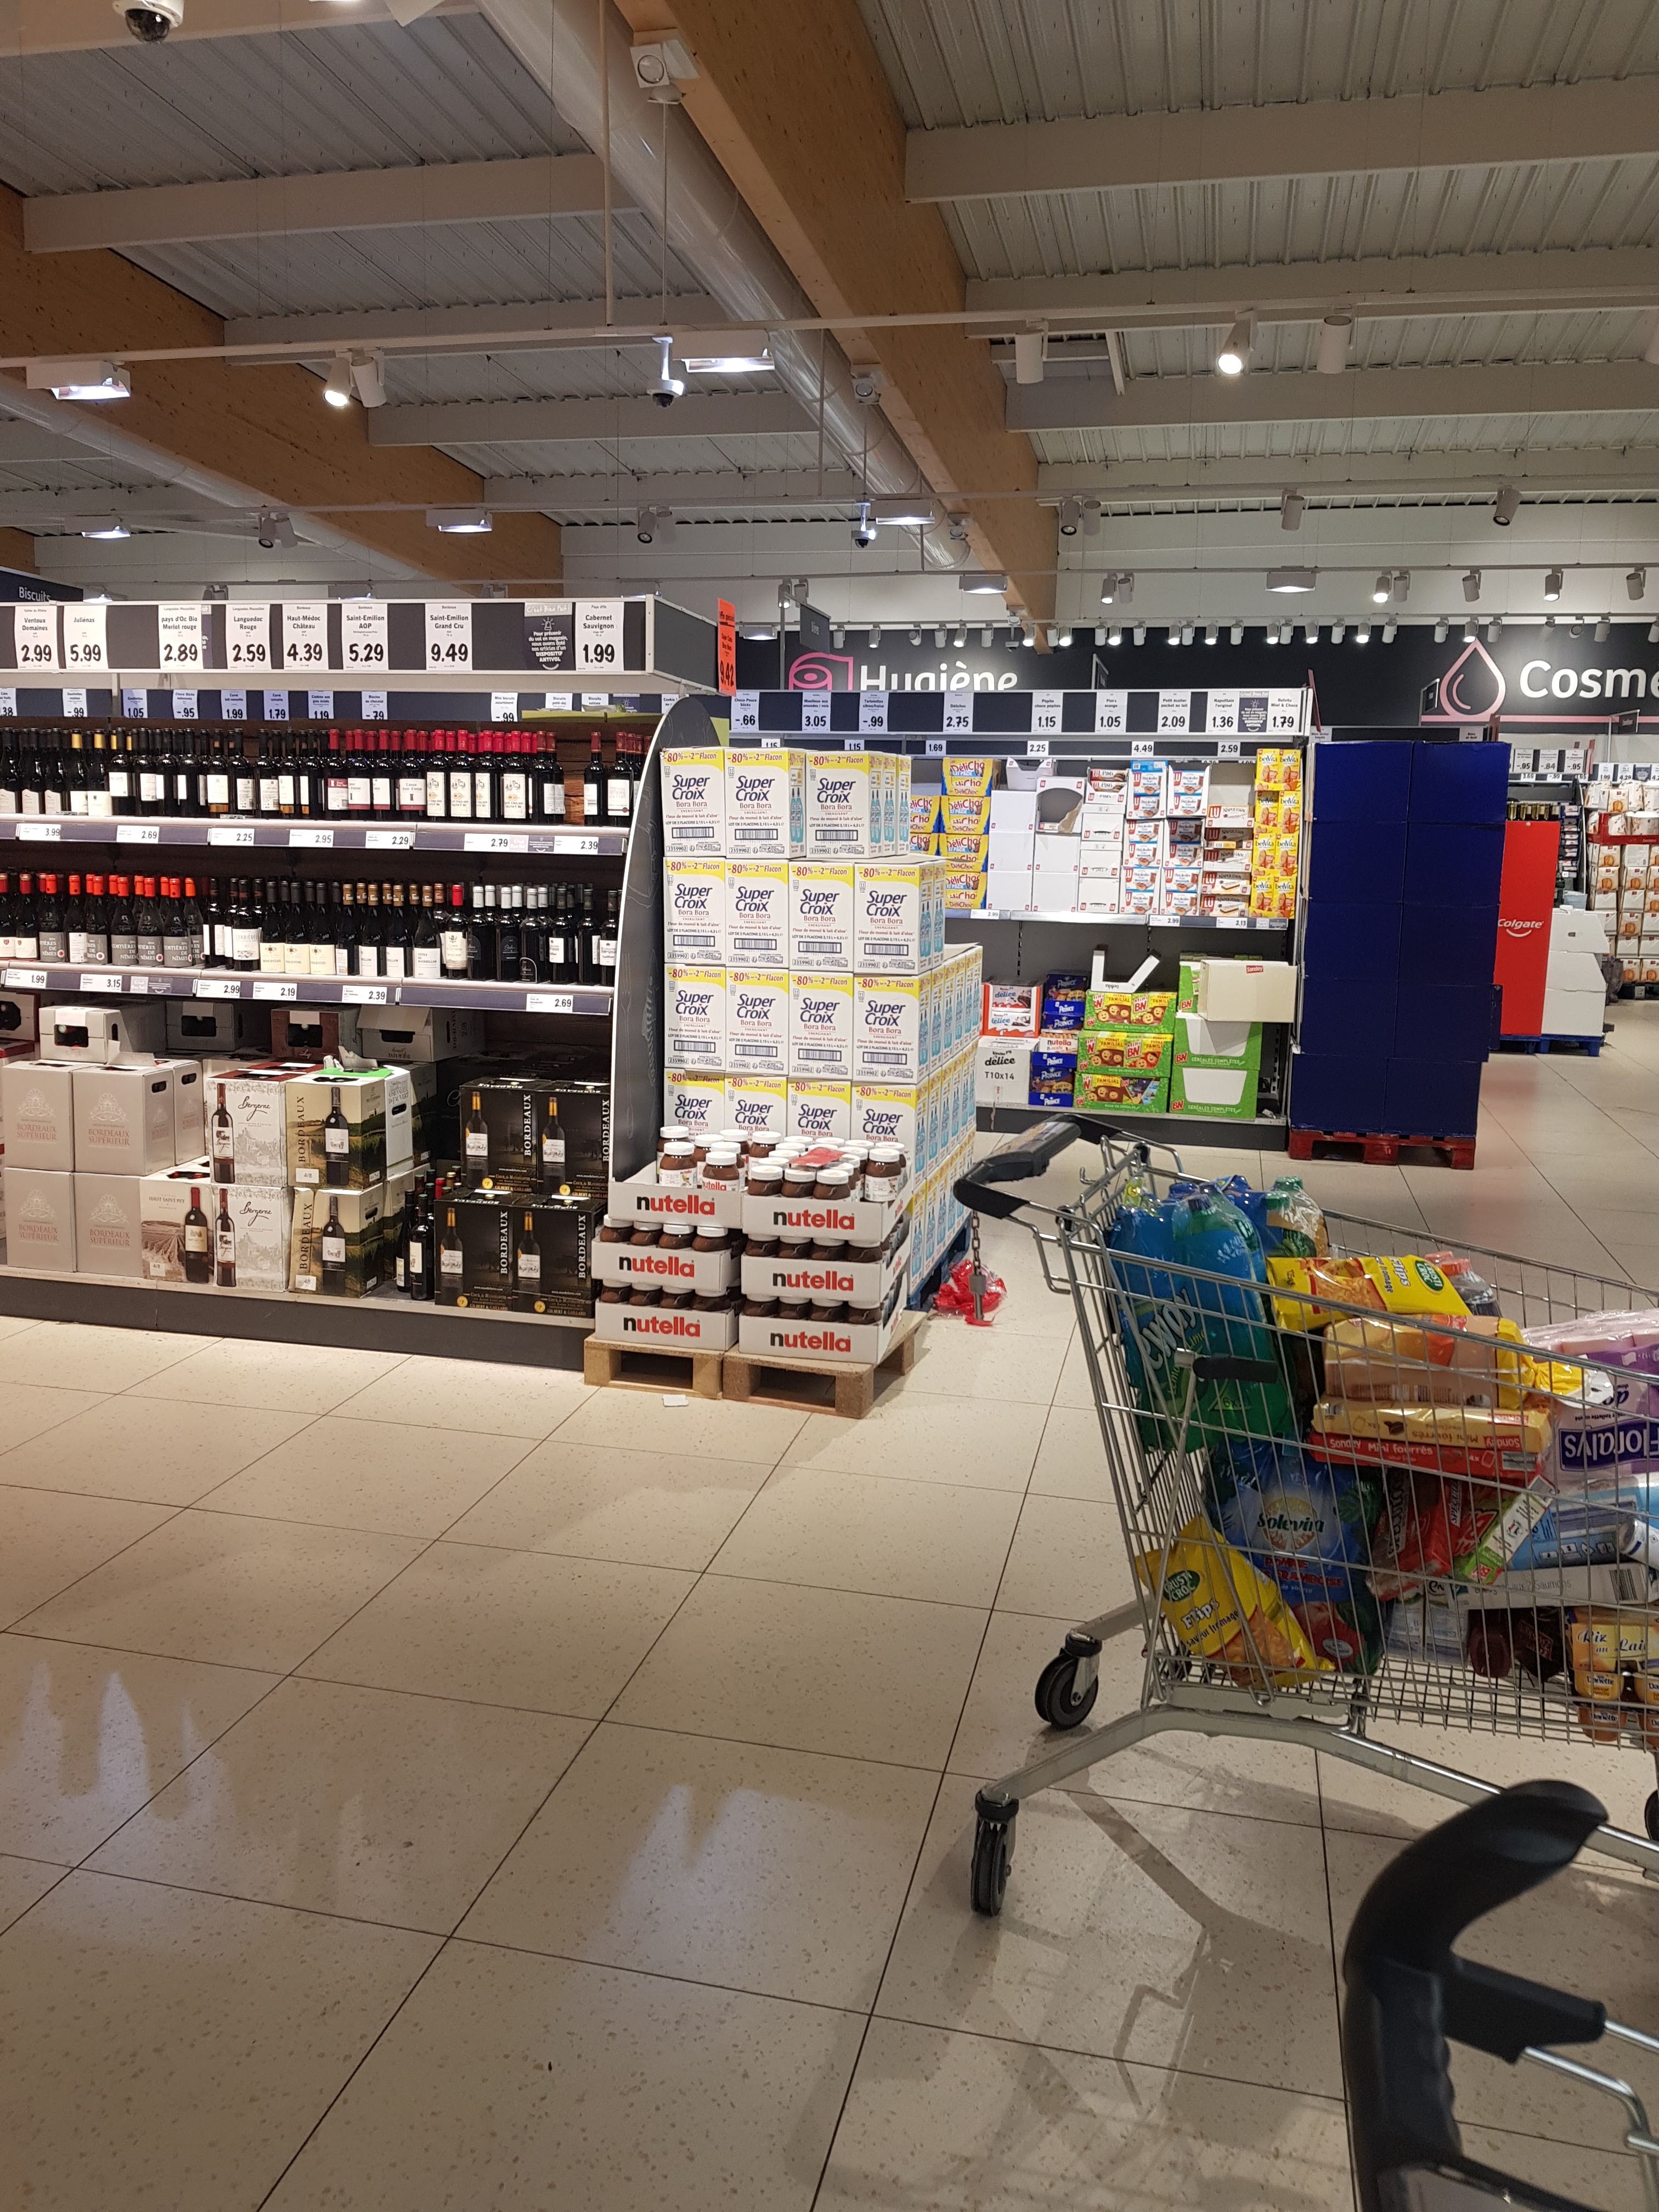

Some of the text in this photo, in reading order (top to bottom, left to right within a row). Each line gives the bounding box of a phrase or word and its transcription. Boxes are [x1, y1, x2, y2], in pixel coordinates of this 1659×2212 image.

[19, 586, 51, 602] Biscuits
[21, 644, 52, 662] 2.99
[70, 644, 101, 662] 5.99
[163, 644, 198, 662] 2.89
[232, 644, 266, 662] 2.59
[287, 643, 323, 662] 4.39
[349, 643, 383, 662] 5.29
[431, 643, 468, 662] 9.49
[583, 644, 615, 663] 1.99
[720, 662, 734, 687] 9.42
[128, 708, 144, 718] 1.05
[177, 708, 194, 718] -.95
[227, 709, 243, 719] 1.99
[269, 709, 285, 719] 1.79
[735, 715, 755, 726] -.66
[805, 715, 826, 727] 3.05
[862, 715, 883, 727] -.99
[946, 716, 969, 727] 2.75
[1038, 716, 1056, 727] 1.15
[1100, 716, 1121, 727] 1.05
[1161, 716, 1185, 727] 2.09
[1212, 716, 1233, 727] 1.36
[1272, 716, 1294, 728] 1.79
[1030, 744, 1046, 752] 2.25
[1134, 744, 1152, 753] 4.49
[672, 774, 710, 789] Super
[736, 775, 775, 791] Super
[818, 778, 856, 793] Super
[672, 787, 705, 800] Croix
[736, 788, 770, 801] Croix
[817, 790, 851, 803] Croix
[1209, 806, 1221, 817] LU
[45, 828, 60, 837] 3.99
[142, 831, 157, 839] 2.69
[236, 833, 252, 842] 2.25
[315, 835, 331, 844] 2.95
[392, 837, 409, 845] 2.29
[491, 838, 509, 848] 2.79
[580, 840, 598, 850] 2.39
[898, 868, 916, 877] Flacon
[736, 886, 774, 902] Super
[867, 890, 907, 906] Super
[735, 899, 769, 912] Croix
[866, 903, 900, 917] Croix
[1498, 918, 1543, 929] Colgate
[31, 974, 45, 984] 1.99
[106, 979, 121, 988] 3.15
[224, 985, 240, 994] 2.99
[280, 988, 295, 996] 2.19
[369, 991, 386, 1000] 2.39
[554, 998, 572, 1007] 2.69
[866, 1000, 906, 1015] Super
[1135, 1002, 1147, 1012] BN
[1181, 1000, 1192, 1009] BN
[865, 1013, 899, 1027] Croix
[1176, 1053, 1188, 1063] BN
[736, 1099, 774, 1115] Super
[735, 1112, 768, 1126] Croix
[88, 1128, 130, 1137] BORDEAUX
[297, 1096, 306, 1163] BORDEAUX
[637, 1194, 715, 1215] nutella
[773, 1209, 855, 1230] nutella
[300, 1203, 313, 1270] BORDEAUX
[619, 1255, 695, 1278] nutella
[1417, 1263, 1432, 1284] CROC
[773, 1270, 854, 1291] nutella
[623, 1317, 700, 1338] nutella
[770, 1331, 851, 1353] nutella
[1330, 1438, 1361, 1449] Sondey
[1393, 1443, 1433, 1455] fourrés
